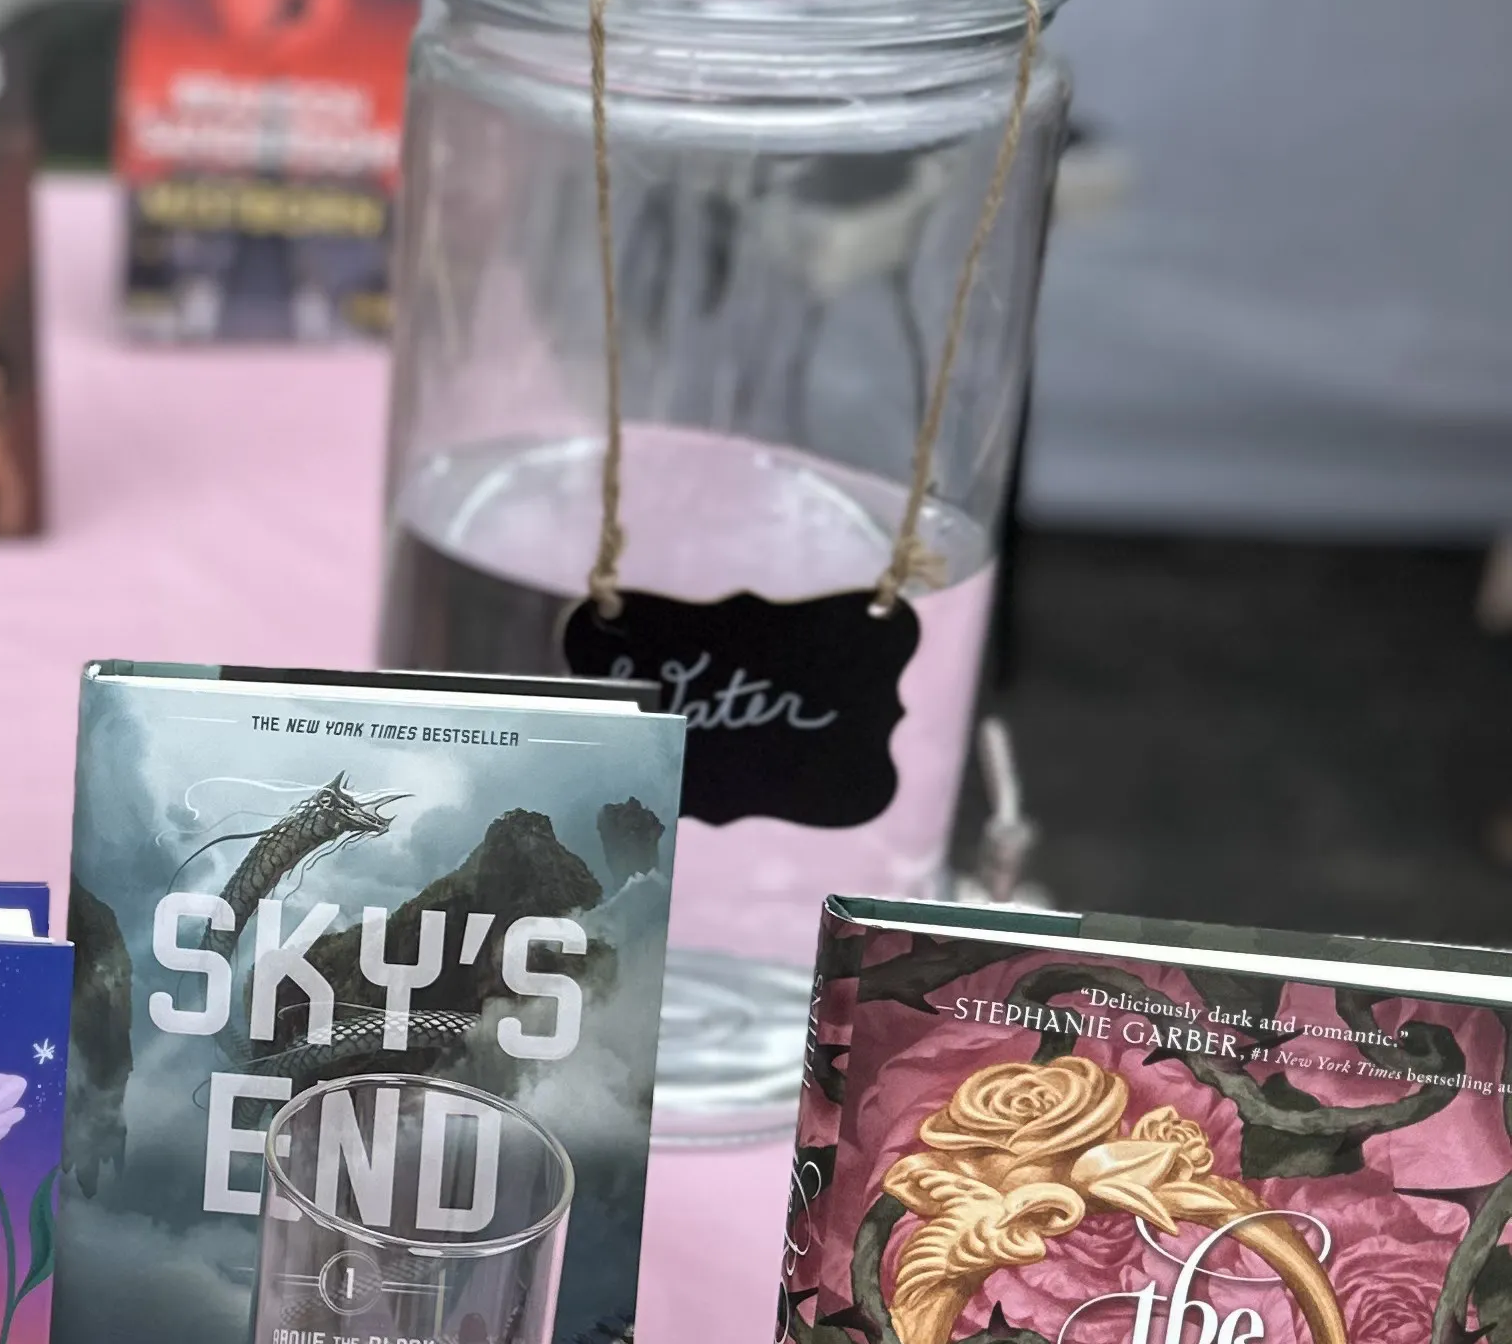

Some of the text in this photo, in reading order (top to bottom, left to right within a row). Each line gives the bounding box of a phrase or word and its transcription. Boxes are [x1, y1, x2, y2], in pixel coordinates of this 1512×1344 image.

[251, 715, 520, 747] THE NEW YORK TIMES BESTSELLER
[148, 891, 588, 1061] SKY'S
[1080, 987, 1409, 1048] “Deliciously dark and romantic.”
[1122, 1020, 1246, 1061] GARBER,
[1251, 1047, 1270, 1063] #1
[1276, 1050, 1313, 1068] New
[1318, 1055, 1352, 1074] York
[1357, 1060, 1403, 1081] Times
[1406, 1067, 1494, 1096] bestselling
[203, 1071, 503, 1233] END
